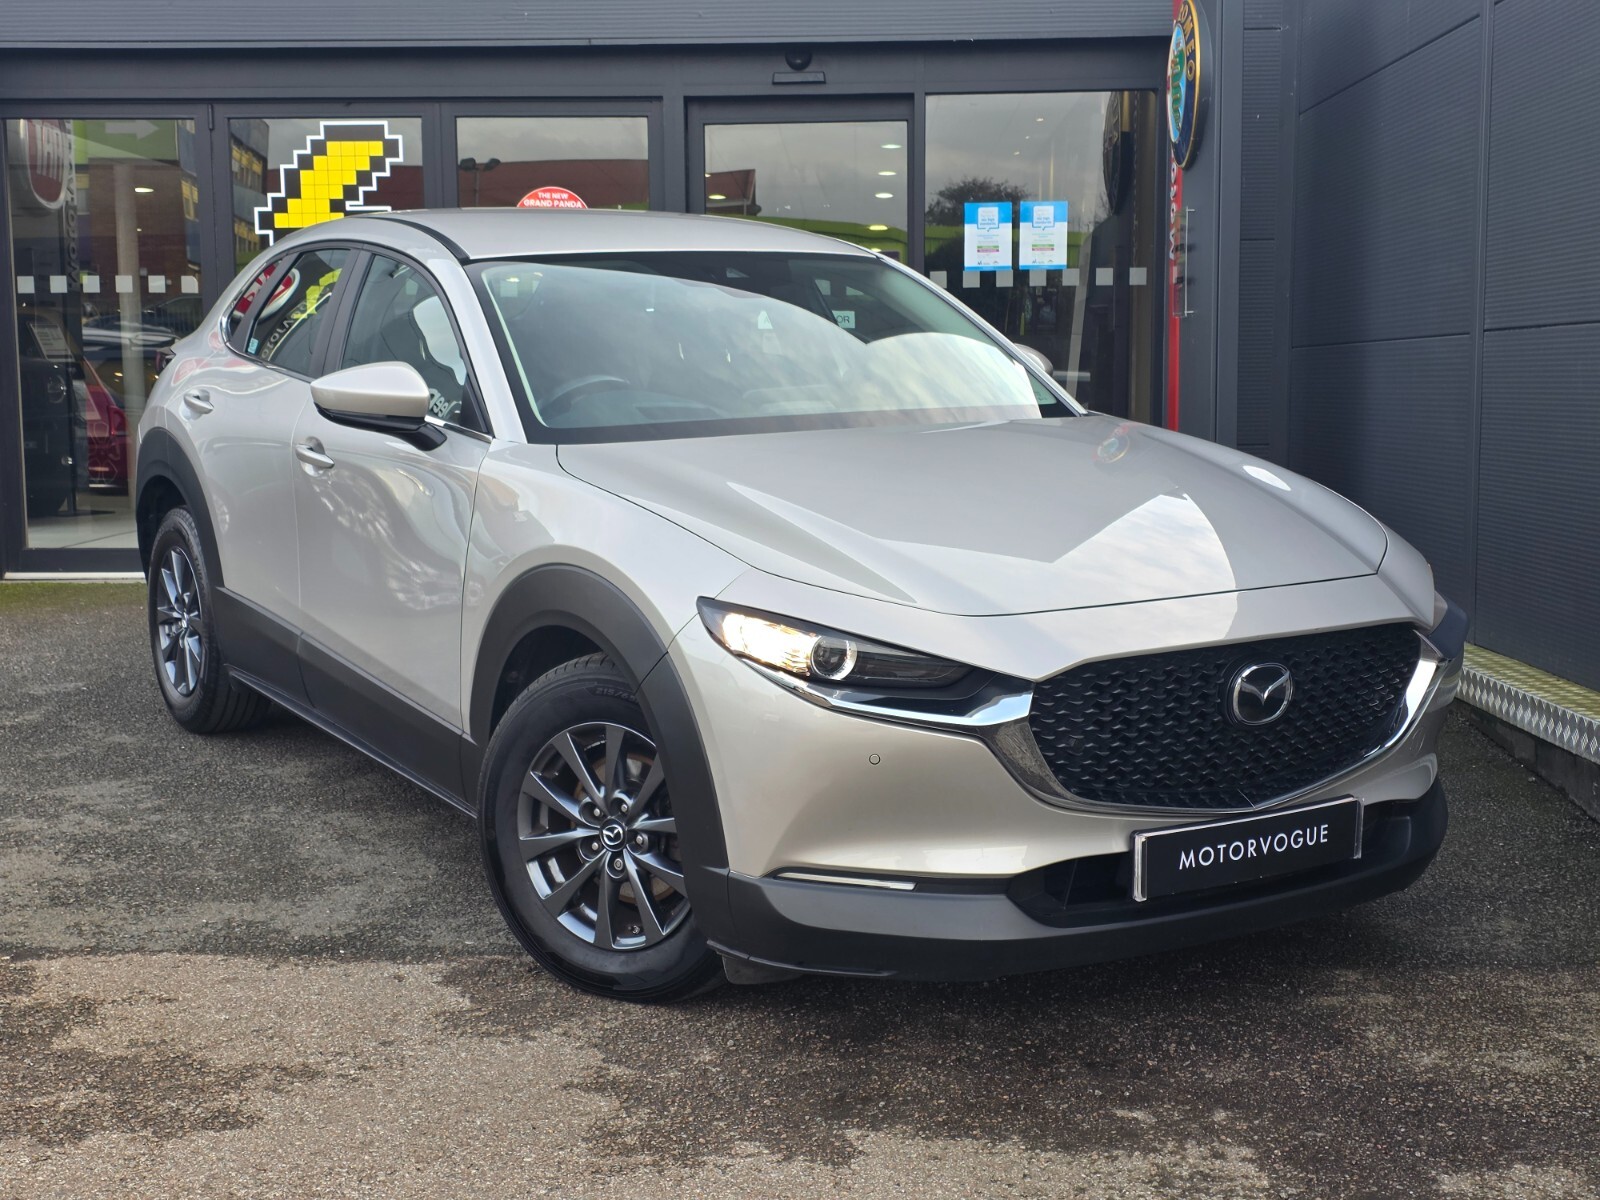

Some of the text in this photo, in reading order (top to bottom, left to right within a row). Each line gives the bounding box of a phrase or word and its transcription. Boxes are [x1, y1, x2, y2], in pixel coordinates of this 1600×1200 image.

[523, 199, 582, 208] GRAND PANDA
[1178, 824, 1329, 870] MOTORVOGUE
